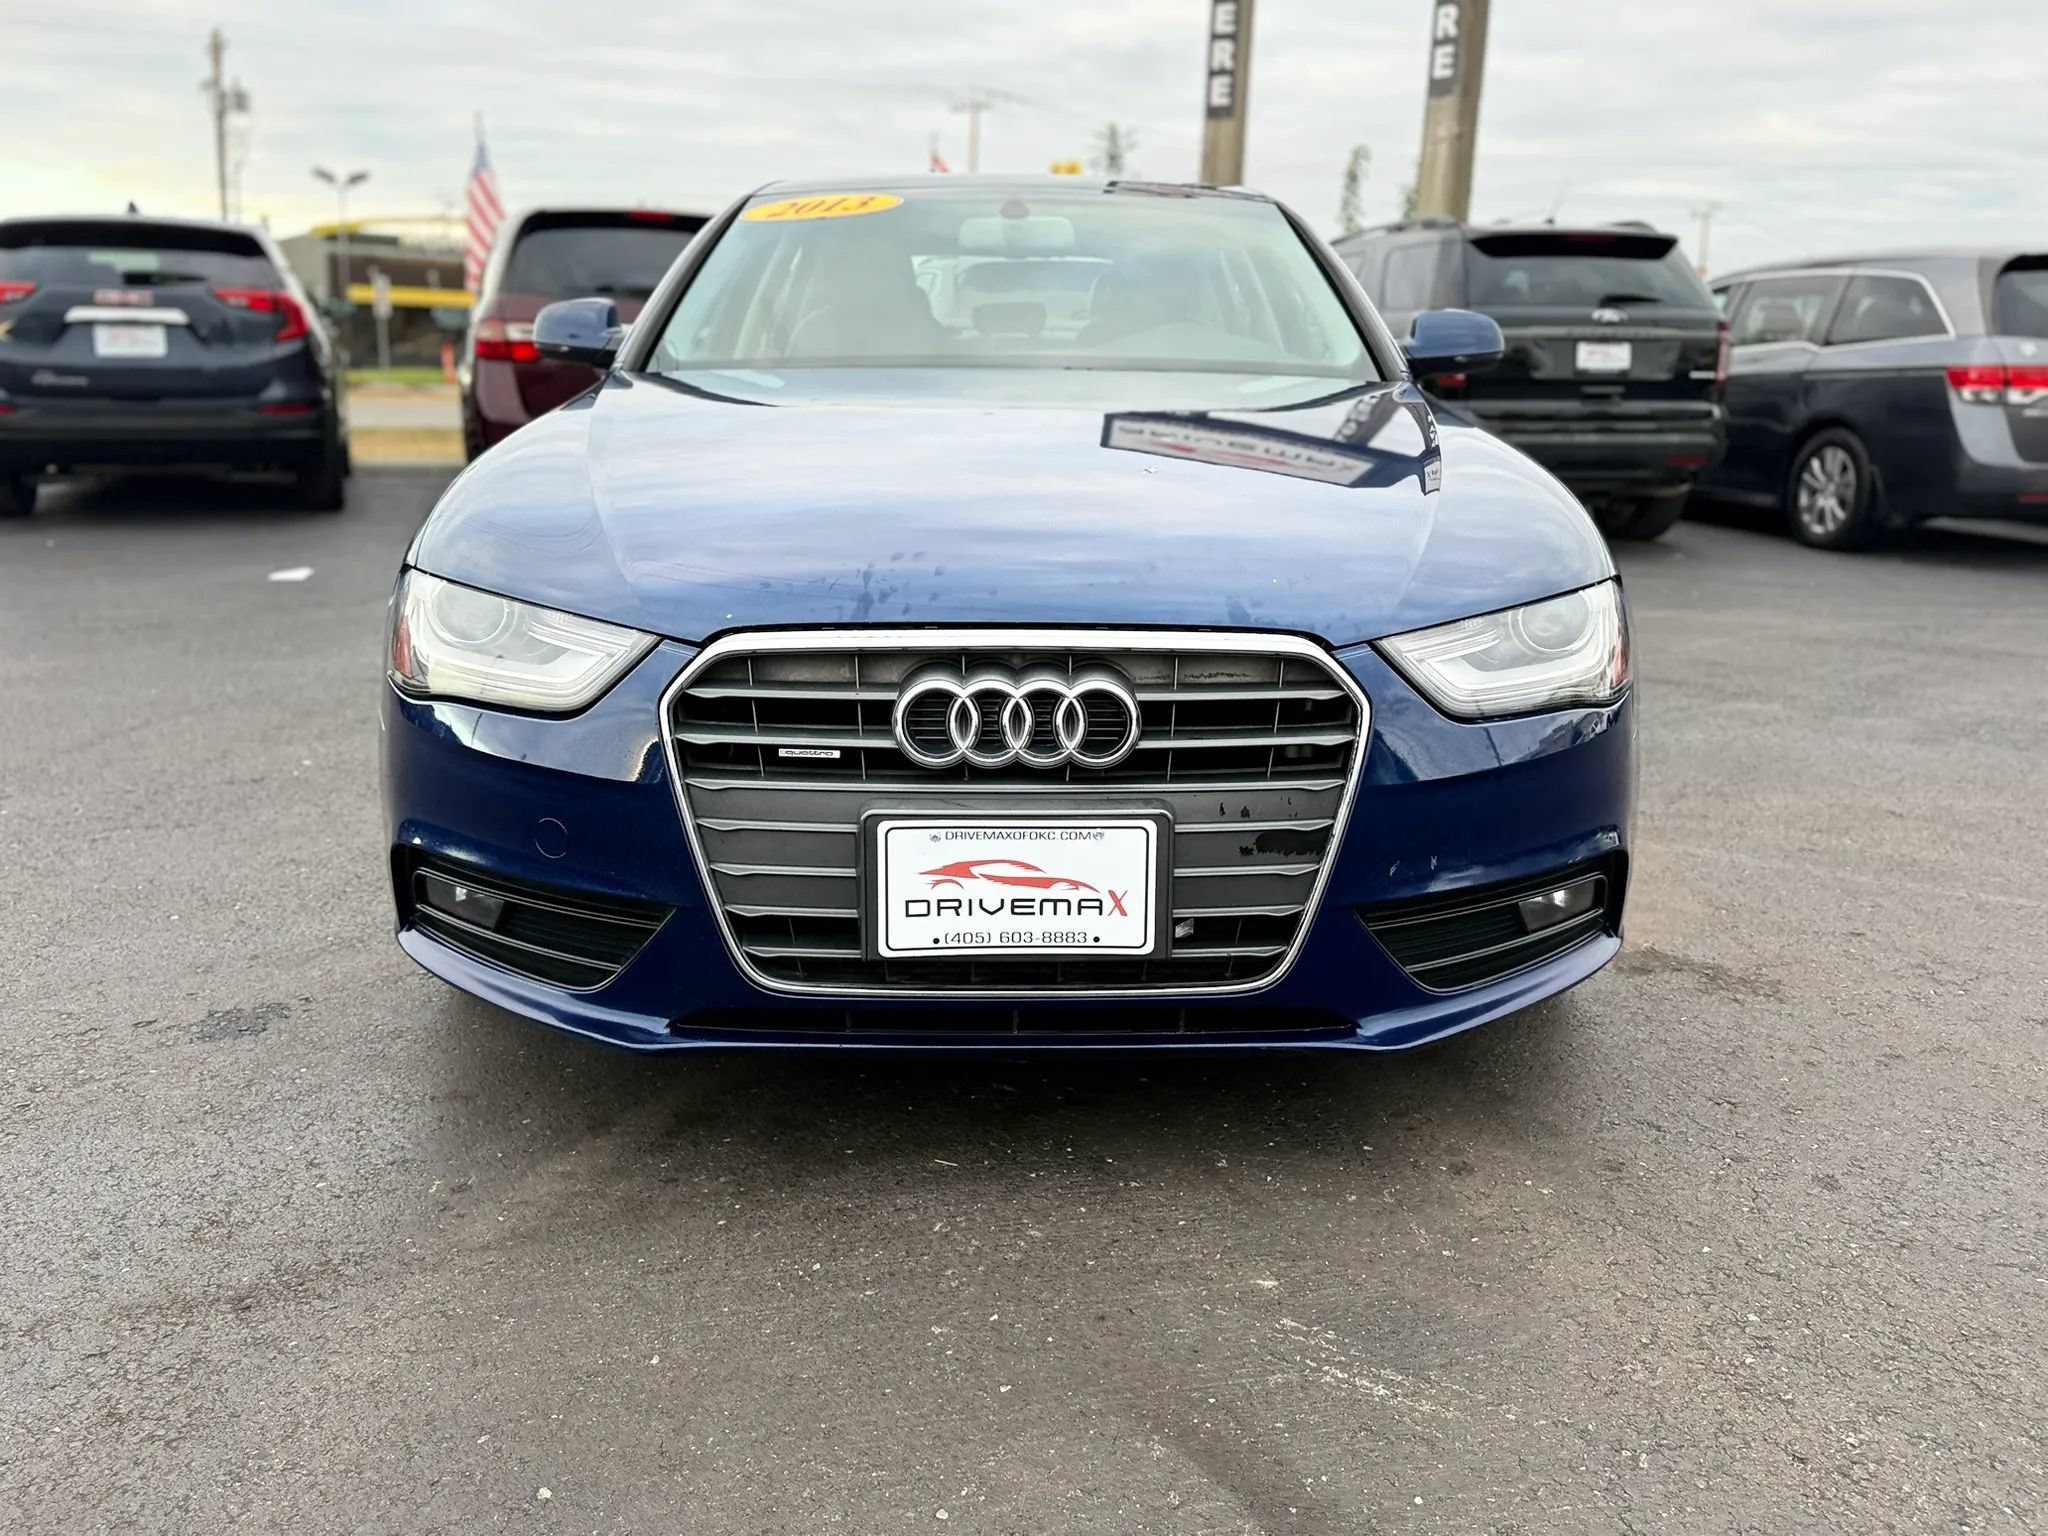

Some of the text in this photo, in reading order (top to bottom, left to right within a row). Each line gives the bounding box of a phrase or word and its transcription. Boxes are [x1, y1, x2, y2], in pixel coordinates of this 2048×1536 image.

[765, 196, 878, 219] 2013
[945, 831, 1092, 841] DRIVEMAXOFOKC.COM
[905, 890, 1128, 918] DRIVEMAX
[944, 931, 1088, 944] (405) 603-8883
